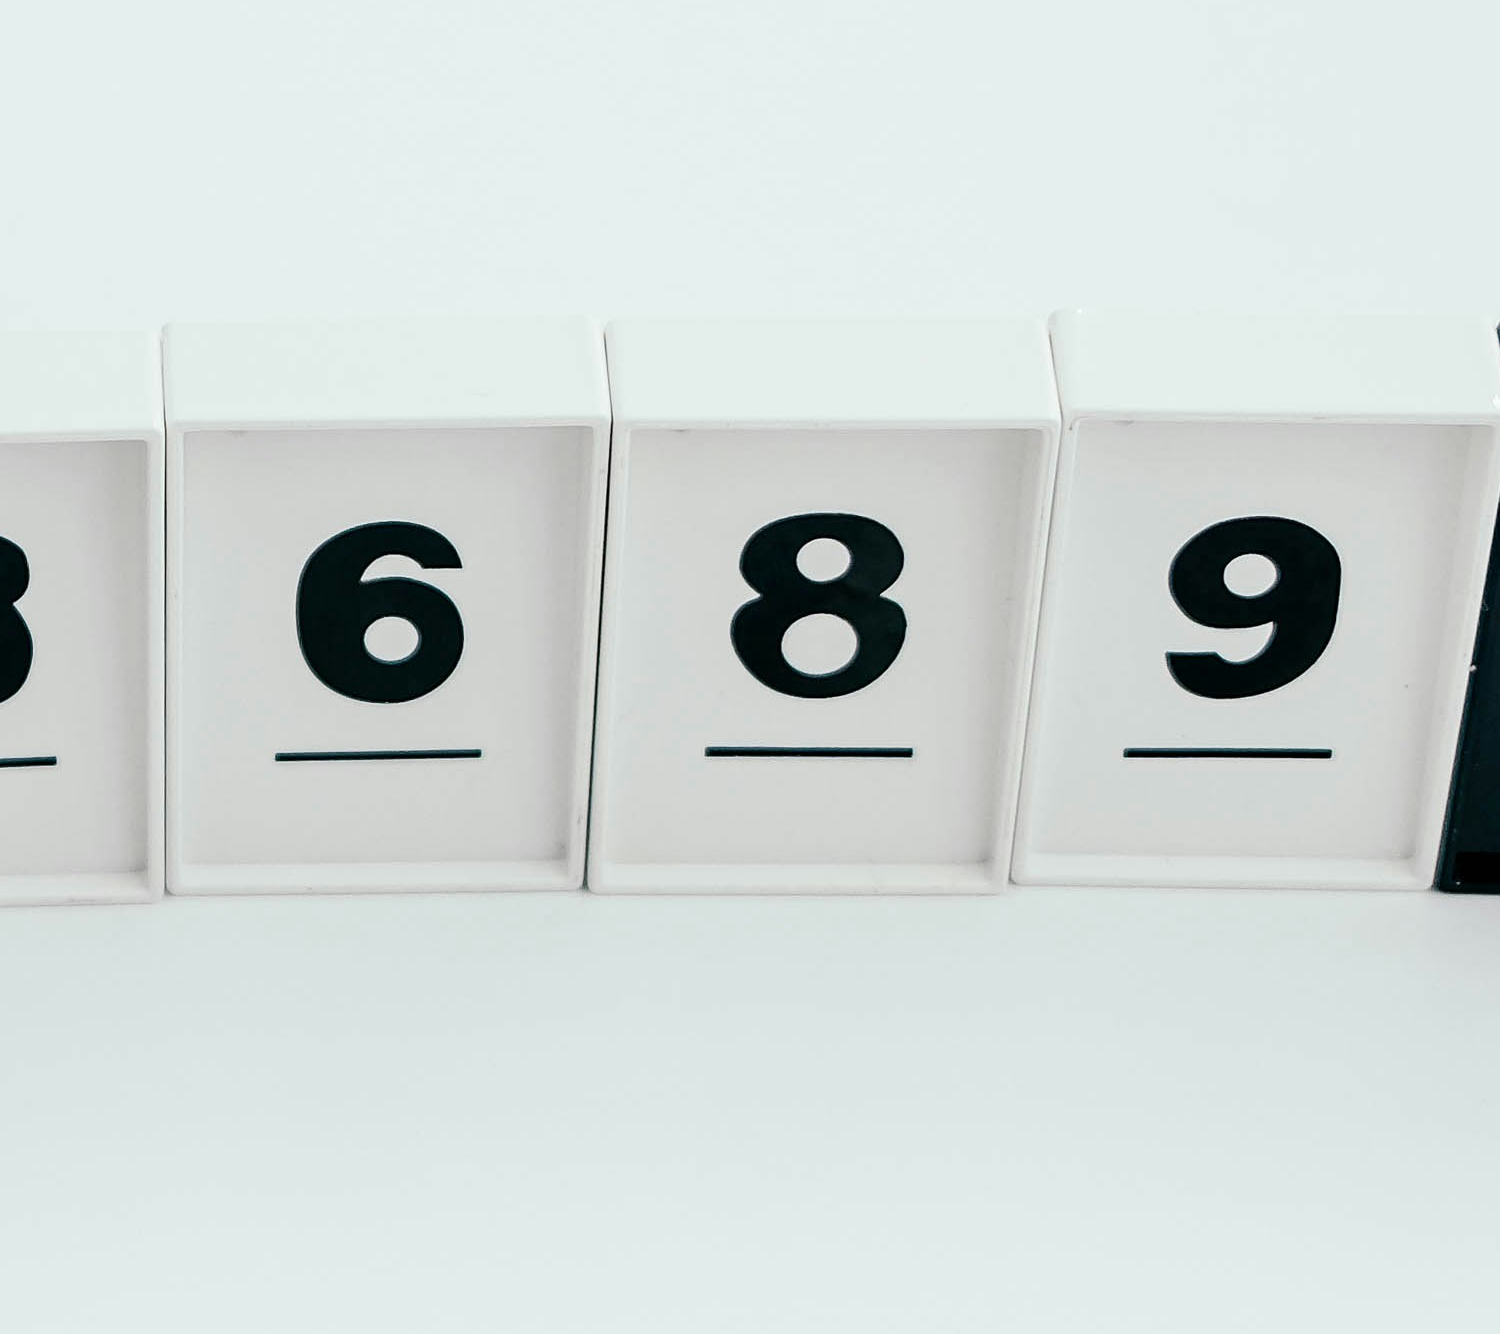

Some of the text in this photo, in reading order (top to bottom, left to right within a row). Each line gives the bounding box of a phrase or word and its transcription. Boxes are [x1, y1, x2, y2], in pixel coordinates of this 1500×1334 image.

[296, 521, 464, 703] 6
[730, 513, 907, 698] 8
[1166, 516, 1341, 699] 9
